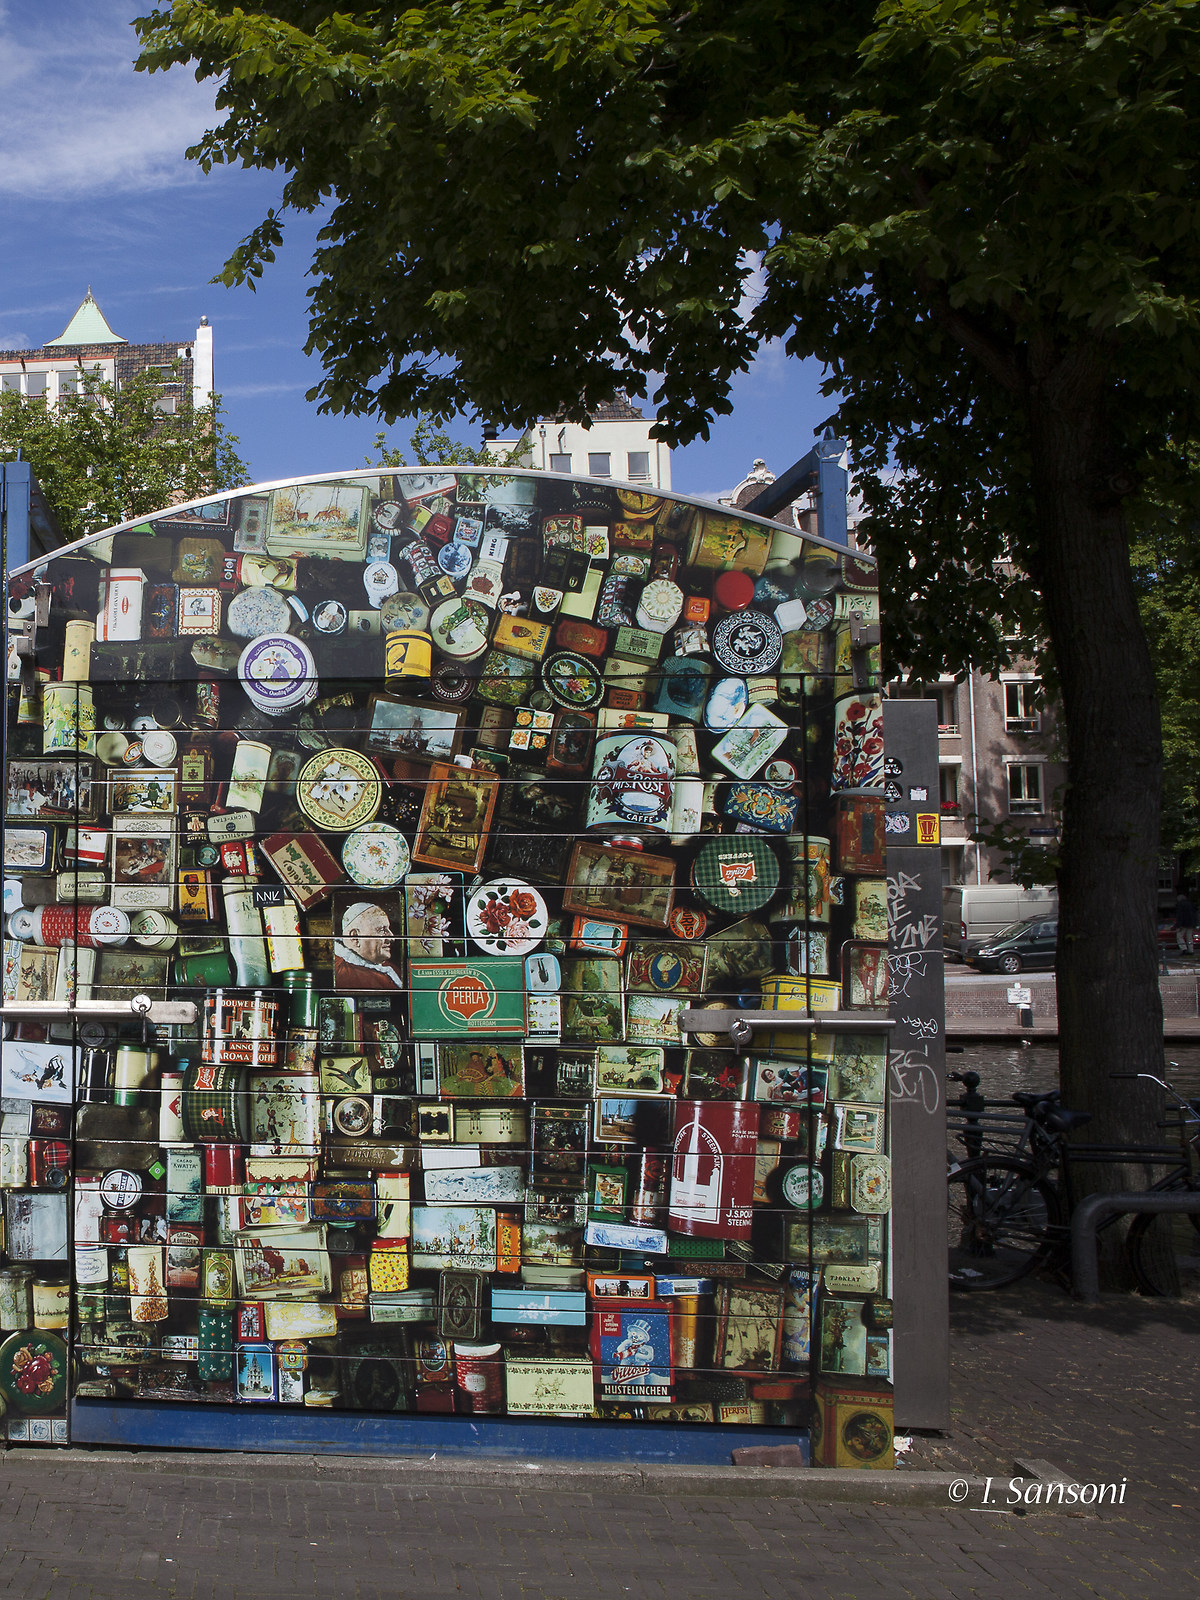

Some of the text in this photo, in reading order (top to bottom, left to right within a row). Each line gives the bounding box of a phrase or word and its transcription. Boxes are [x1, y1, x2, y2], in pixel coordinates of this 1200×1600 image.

[488, 537, 498, 557] KING
[612, 773, 667, 796] Mrs. ROSE
[718, 851, 754, 861] TOFFEES
[452, 986, 485, 1005] PERLA
[230, 1043, 253, 1051] ANNO
[604, 1385, 669, 1396] HUSTELINCHEN
[720, 1406, 749, 1420] HERFST
